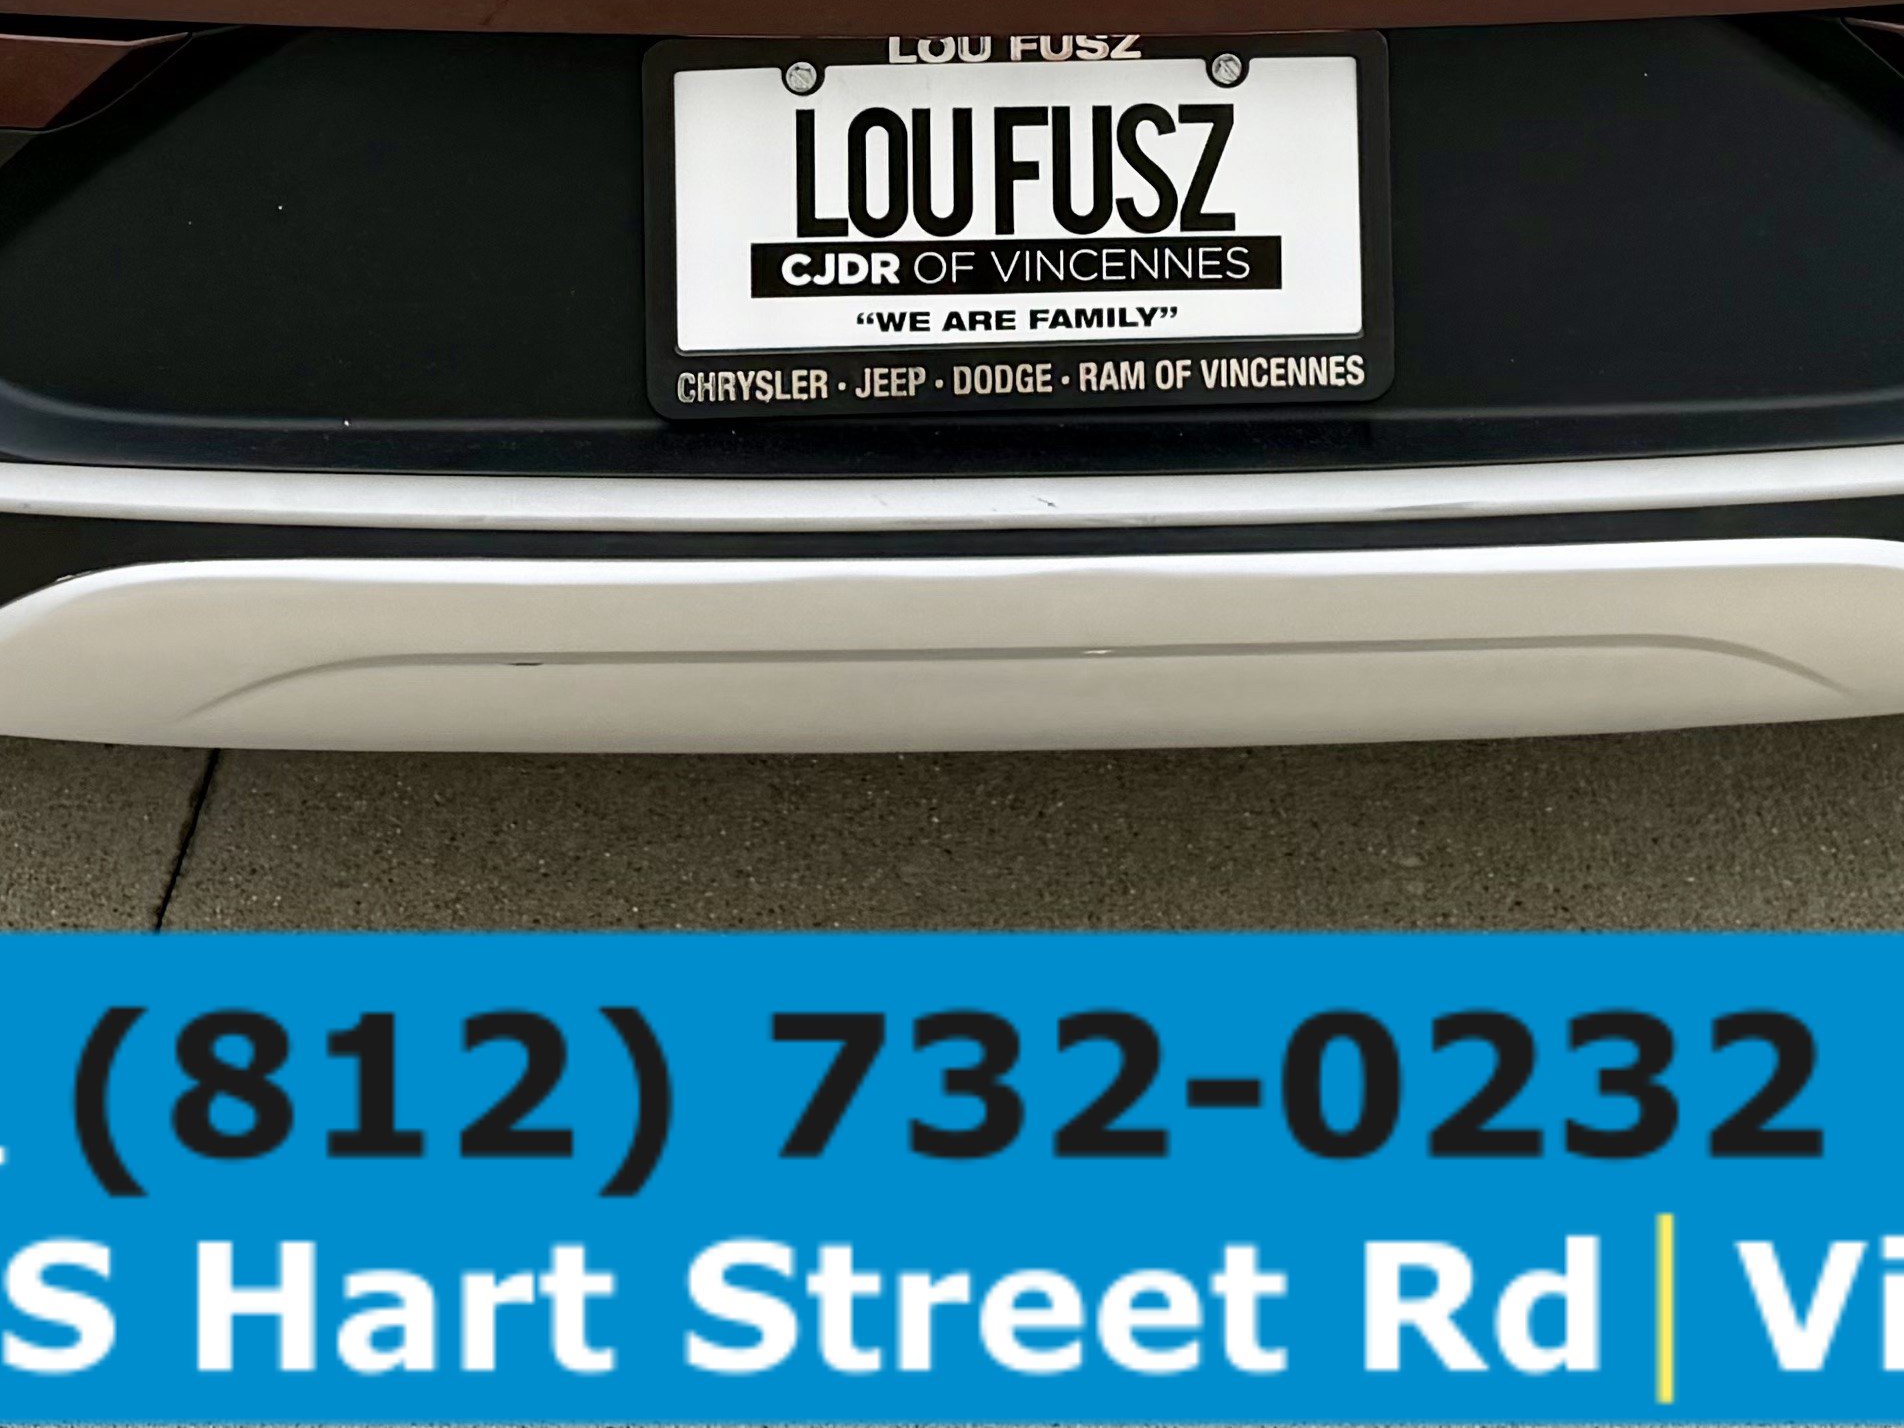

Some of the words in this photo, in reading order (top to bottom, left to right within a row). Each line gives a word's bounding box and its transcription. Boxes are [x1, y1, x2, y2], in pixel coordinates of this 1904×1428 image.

[888, 35, 992, 64] LOU
[1010, 34, 1142, 62] FUSZ
[795, 105, 974, 239] LOU
[994, 102, 1237, 236] FUSZ
[781, 252, 900, 286] CJDR
[913, 251, 976, 284] OF
[990, 246, 1251, 283] VINCENNES
[856, 309, 931, 334] “WE
[942, 308, 1017, 332] ARE
[1029, 305, 1179, 331] FAMILY”
[676, 368, 829, 406] CHRYSLER
[855, 366, 927, 398] JEEP
[952, 362, 1053, 396] DODGE
[1079, 360, 1150, 393] RAM
[1155, 359, 1193, 390] OF
[1200, 354, 1366, 388] VINCENNES
